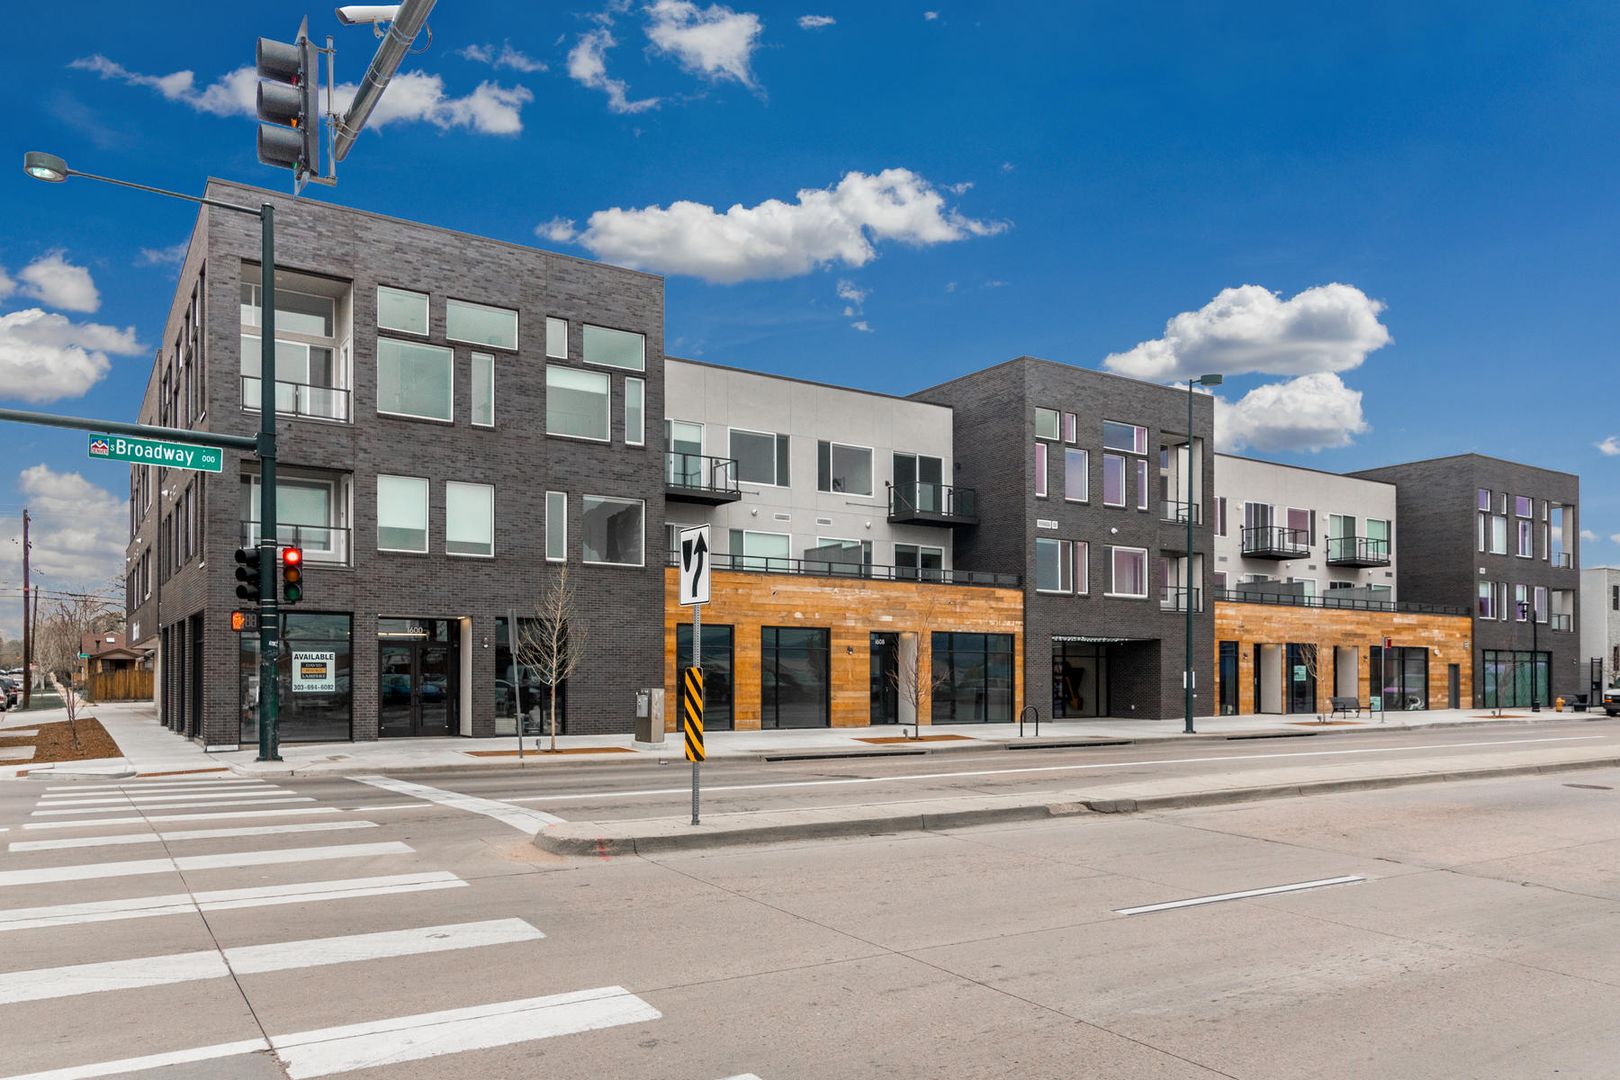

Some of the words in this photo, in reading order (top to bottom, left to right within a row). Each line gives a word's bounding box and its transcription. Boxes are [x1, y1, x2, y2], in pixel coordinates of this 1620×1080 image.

[110, 444, 115, 452] S
[116, 439, 194, 466] Broadway
[407, 626, 423, 634] 1600
